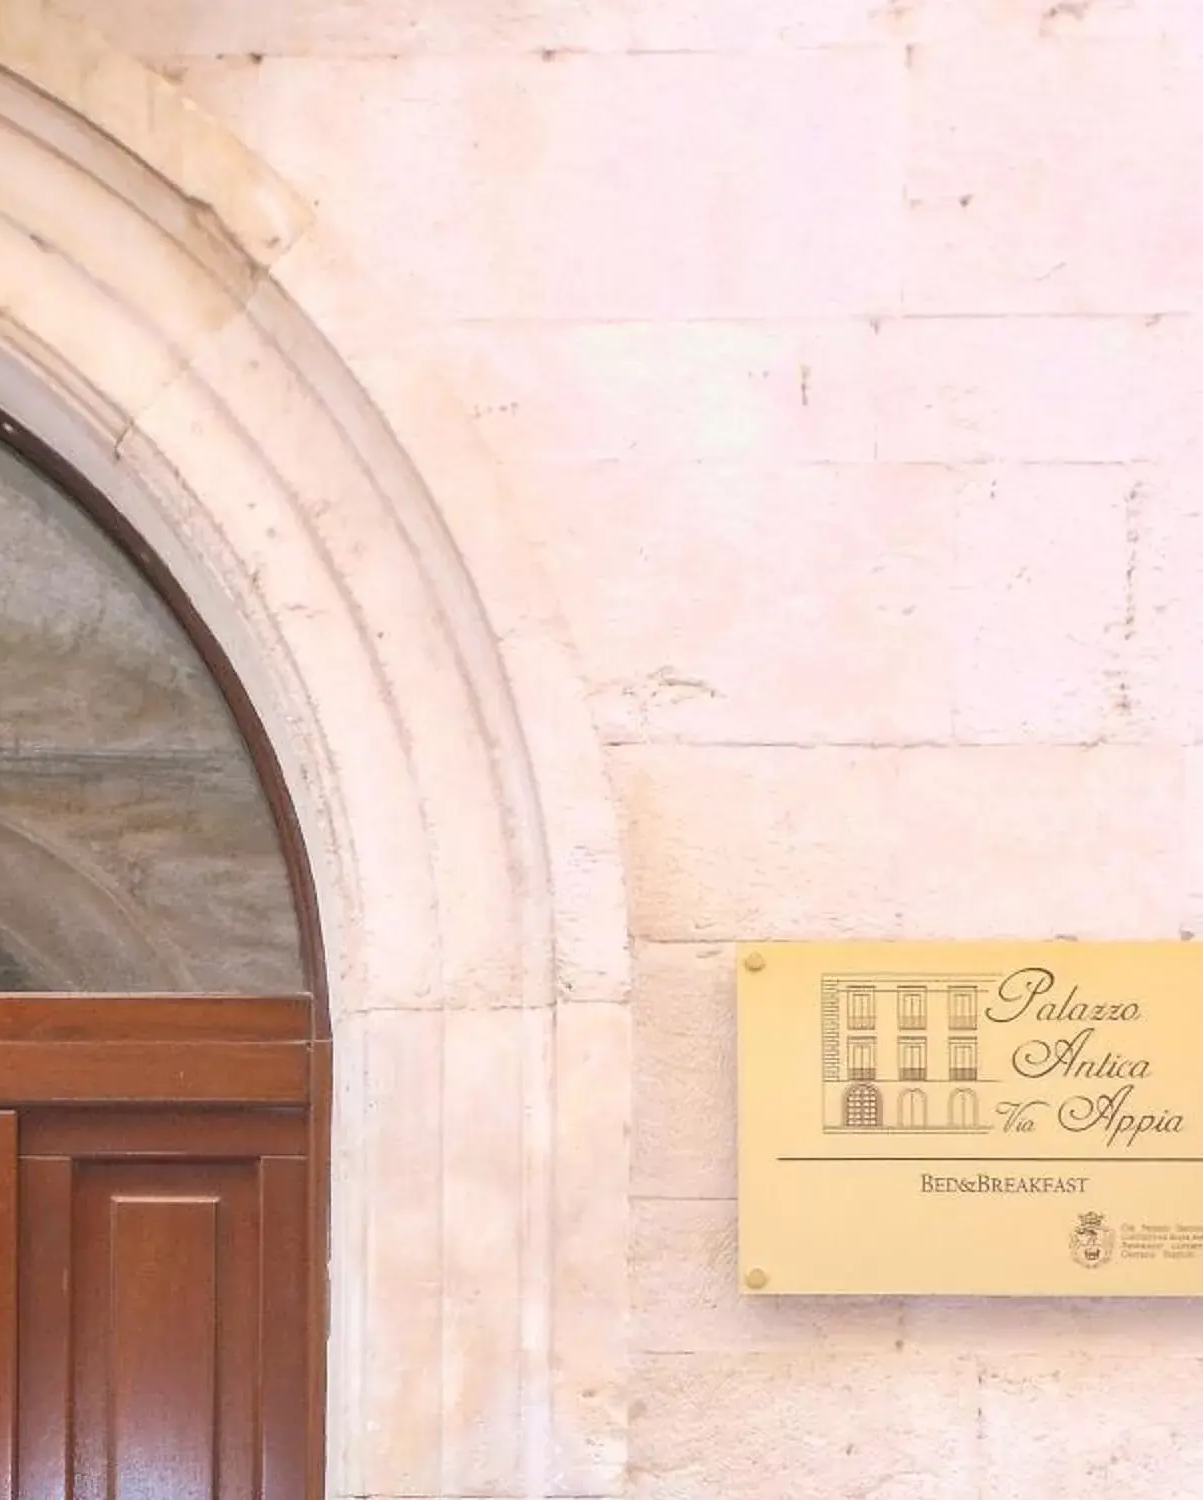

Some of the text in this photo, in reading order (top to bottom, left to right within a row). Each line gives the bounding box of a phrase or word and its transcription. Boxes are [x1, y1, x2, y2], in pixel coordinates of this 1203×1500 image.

[984, 967, 1140, 1022] Palazzo
[1012, 1028, 1151, 1078] Antica
[995, 1084, 1184, 1147] Via Appia
